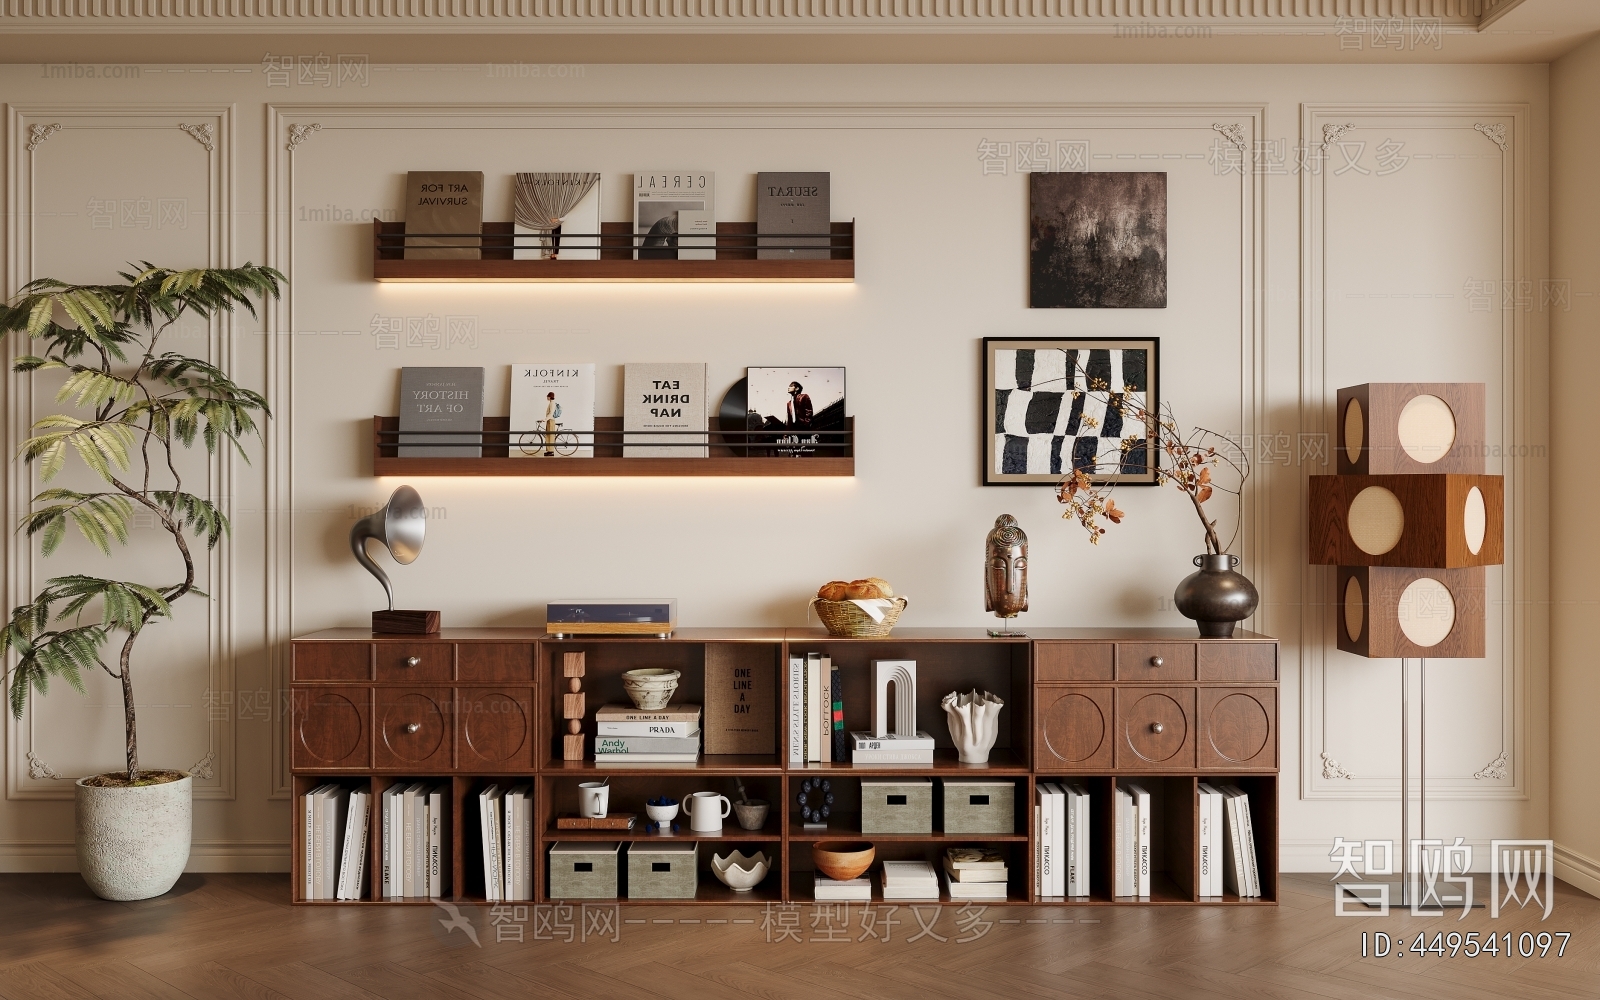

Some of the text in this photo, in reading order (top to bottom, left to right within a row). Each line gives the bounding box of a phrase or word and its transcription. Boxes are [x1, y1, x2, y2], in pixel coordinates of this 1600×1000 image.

[734, 669, 751, 678] ONE
[733, 680, 752, 690] LINE
[740, 694, 745, 702] A
[734, 704, 750, 714] DAY
[602, 739, 625, 748] Andy
